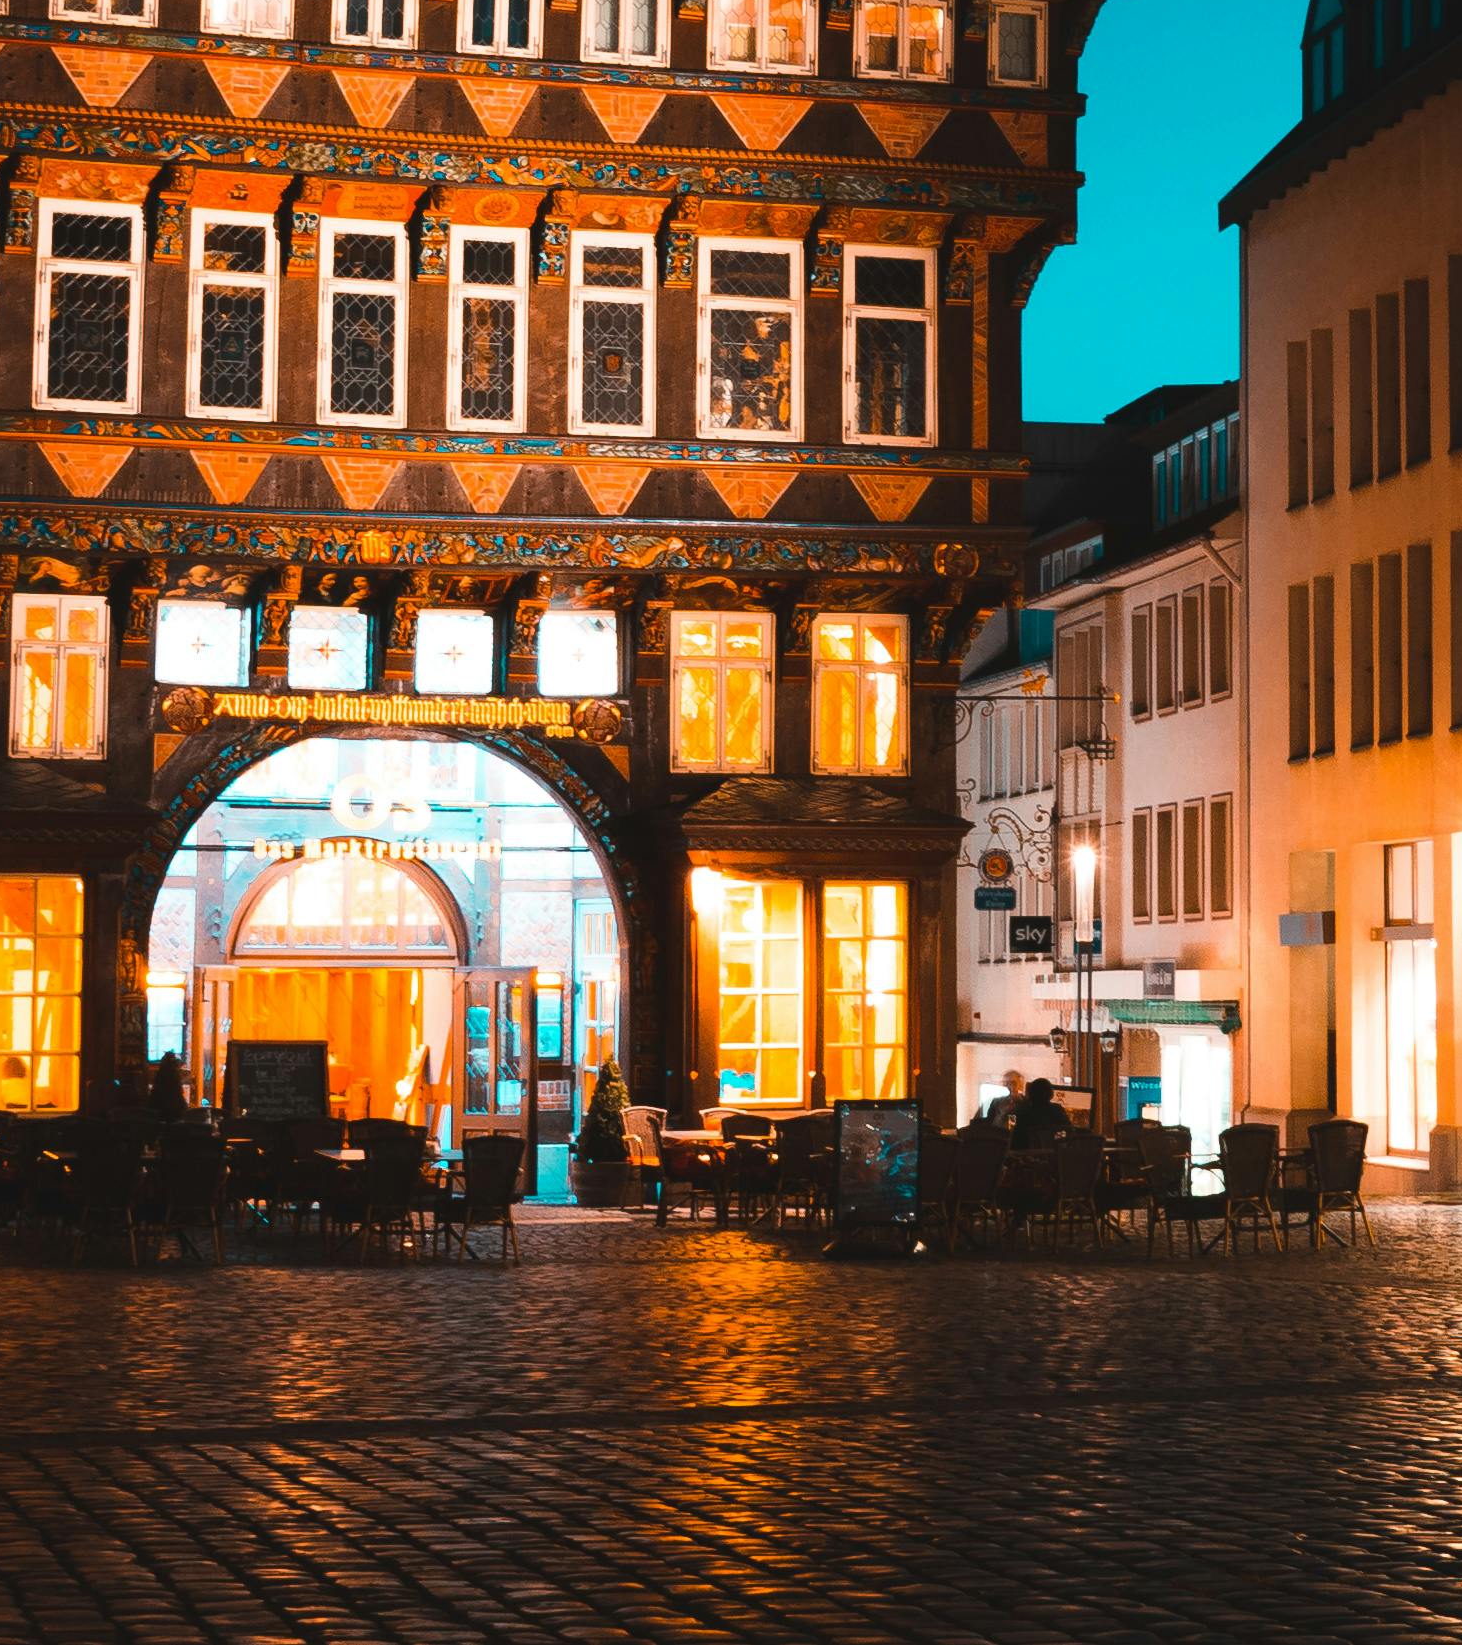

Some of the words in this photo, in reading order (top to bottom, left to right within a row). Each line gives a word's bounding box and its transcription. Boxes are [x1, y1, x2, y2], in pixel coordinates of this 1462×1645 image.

[253, 837, 295, 859] Das
[303, 837, 502, 860] Marktrestaurant
[1015, 925, 1047, 944] sky
